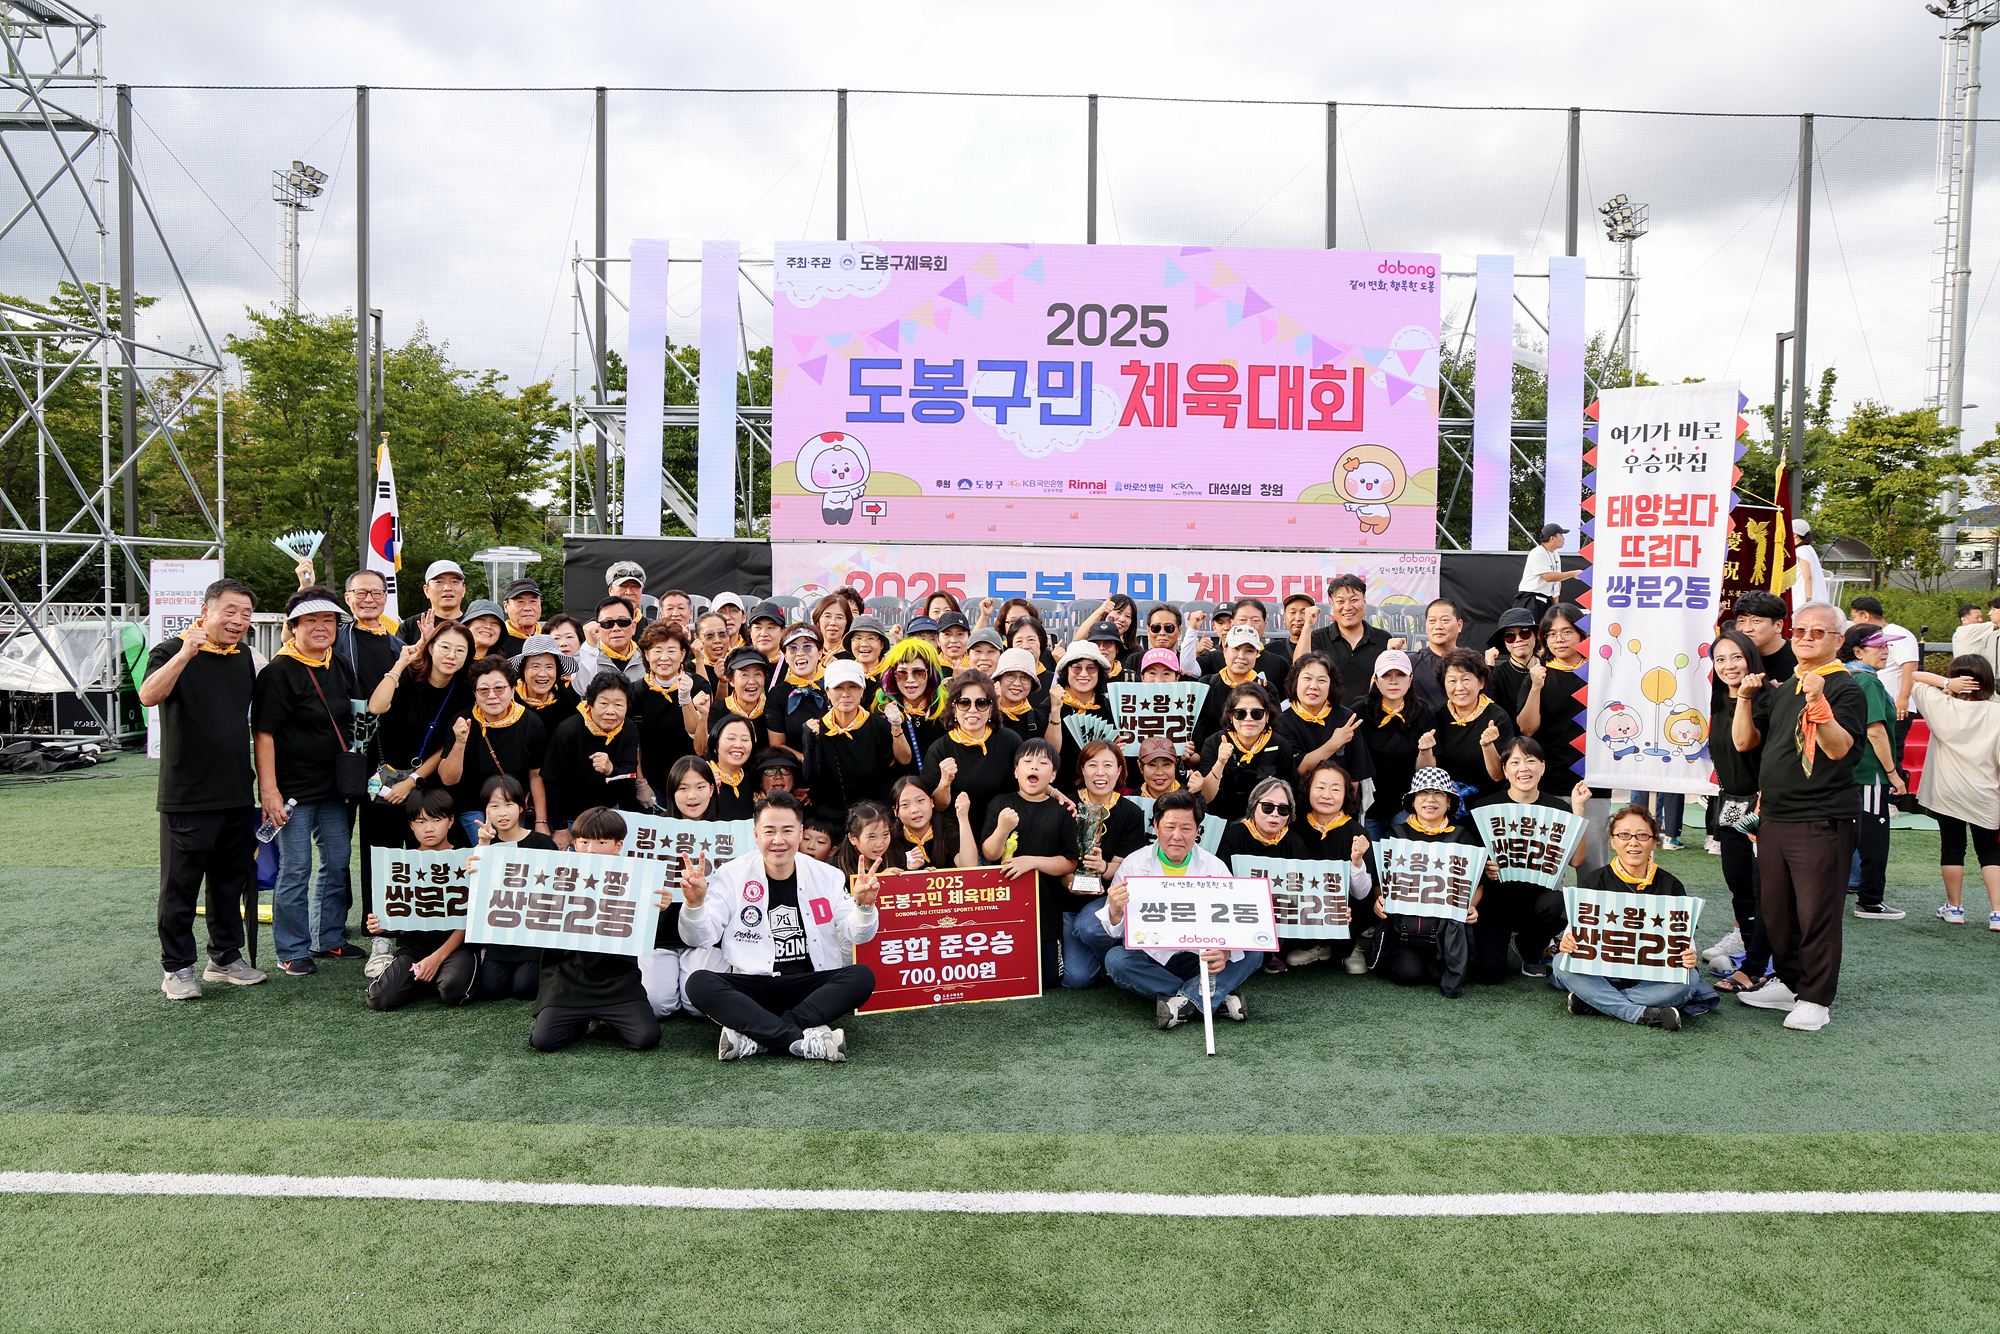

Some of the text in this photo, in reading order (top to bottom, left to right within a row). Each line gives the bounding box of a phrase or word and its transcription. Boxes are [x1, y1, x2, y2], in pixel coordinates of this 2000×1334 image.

[786, 255, 948, 271] 주최·주관 도봉구체육회
[1377, 259, 1436, 278] dobong
[1349, 279, 1366, 290] 같이
[1390, 279, 1418, 292] 행복한
[1420, 280, 1435, 293] 도봉
[1047, 302, 1169, 348] 2025
[846, 358, 1365, 432] 도봉구민 체육대회
[1610, 421, 1723, 445] 여기가 바로
[1621, 452, 1708, 474] 우승맛집
[935, 479, 951, 489] 후원
[975, 480, 1003, 490] 도봉구
[1068, 479, 1107, 490] Rinnai
[1123, 482, 1164, 492] 바로선 병원
[1208, 482, 1251, 496] 대성실업
[1260, 483, 1284, 497] 창원
[1607, 493, 1719, 528] 태양보다
[1399, 553, 1437, 564] dobong
[1618, 534, 1702, 568] 뜨겁다
[845, 571, 966, 608] 2025
[1188, 572, 1367, 608] 체육대
[1606, 575, 1711, 609] 쌍문2동
[1147, 651, 1173, 661] PARIS
[1491, 838, 1566, 876] 쌍문2동
[925, 875, 964, 890] 2025
[1161, 881, 1175, 889] 같이
[1196, 881, 1220, 889] 행복한
[1222, 881, 1234, 890] 도봉
[385, 885, 469, 918] 쌍문2
[879, 886, 1011, 911] 도봉구민 체육대회
[1271, 893, 1348, 926] 문2동
[487, 889, 637, 938] 쌍문2동
[895, 910, 928, 918] DOBONG-GU
[1139, 902, 1260, 924] 쌍문 2동
[879, 930, 1015, 965] 종합 준우승
[1178, 934, 1227, 946] dobong
[1570, 926, 1691, 969] 쌍문2동
[899, 961, 997, 986] 700,000원
